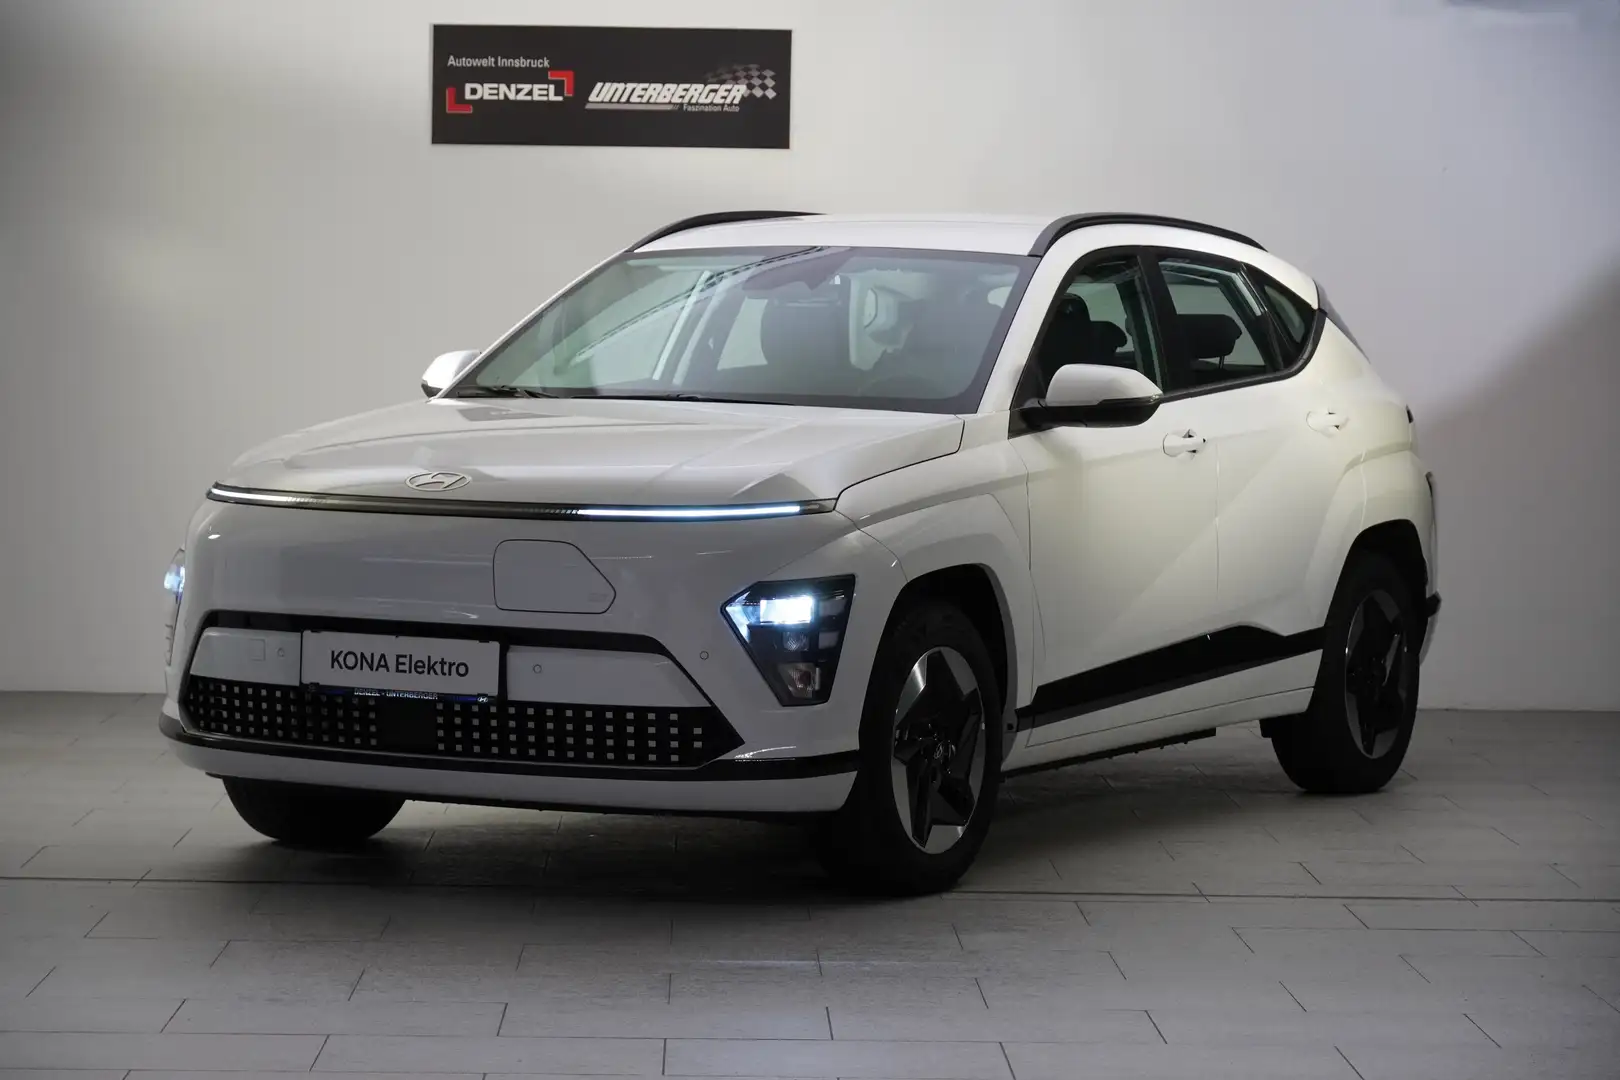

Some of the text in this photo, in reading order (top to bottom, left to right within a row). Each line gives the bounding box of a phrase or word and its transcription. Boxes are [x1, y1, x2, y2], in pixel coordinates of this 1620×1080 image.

[447, 55, 550, 68] Autowelt Innsbruck
[464, 82, 564, 101] DENZEL
[588, 82, 747, 104] UNTERBERGER
[683, 103, 740, 113] Faszination Auto
[330, 650, 469, 678] KONA Elektro
